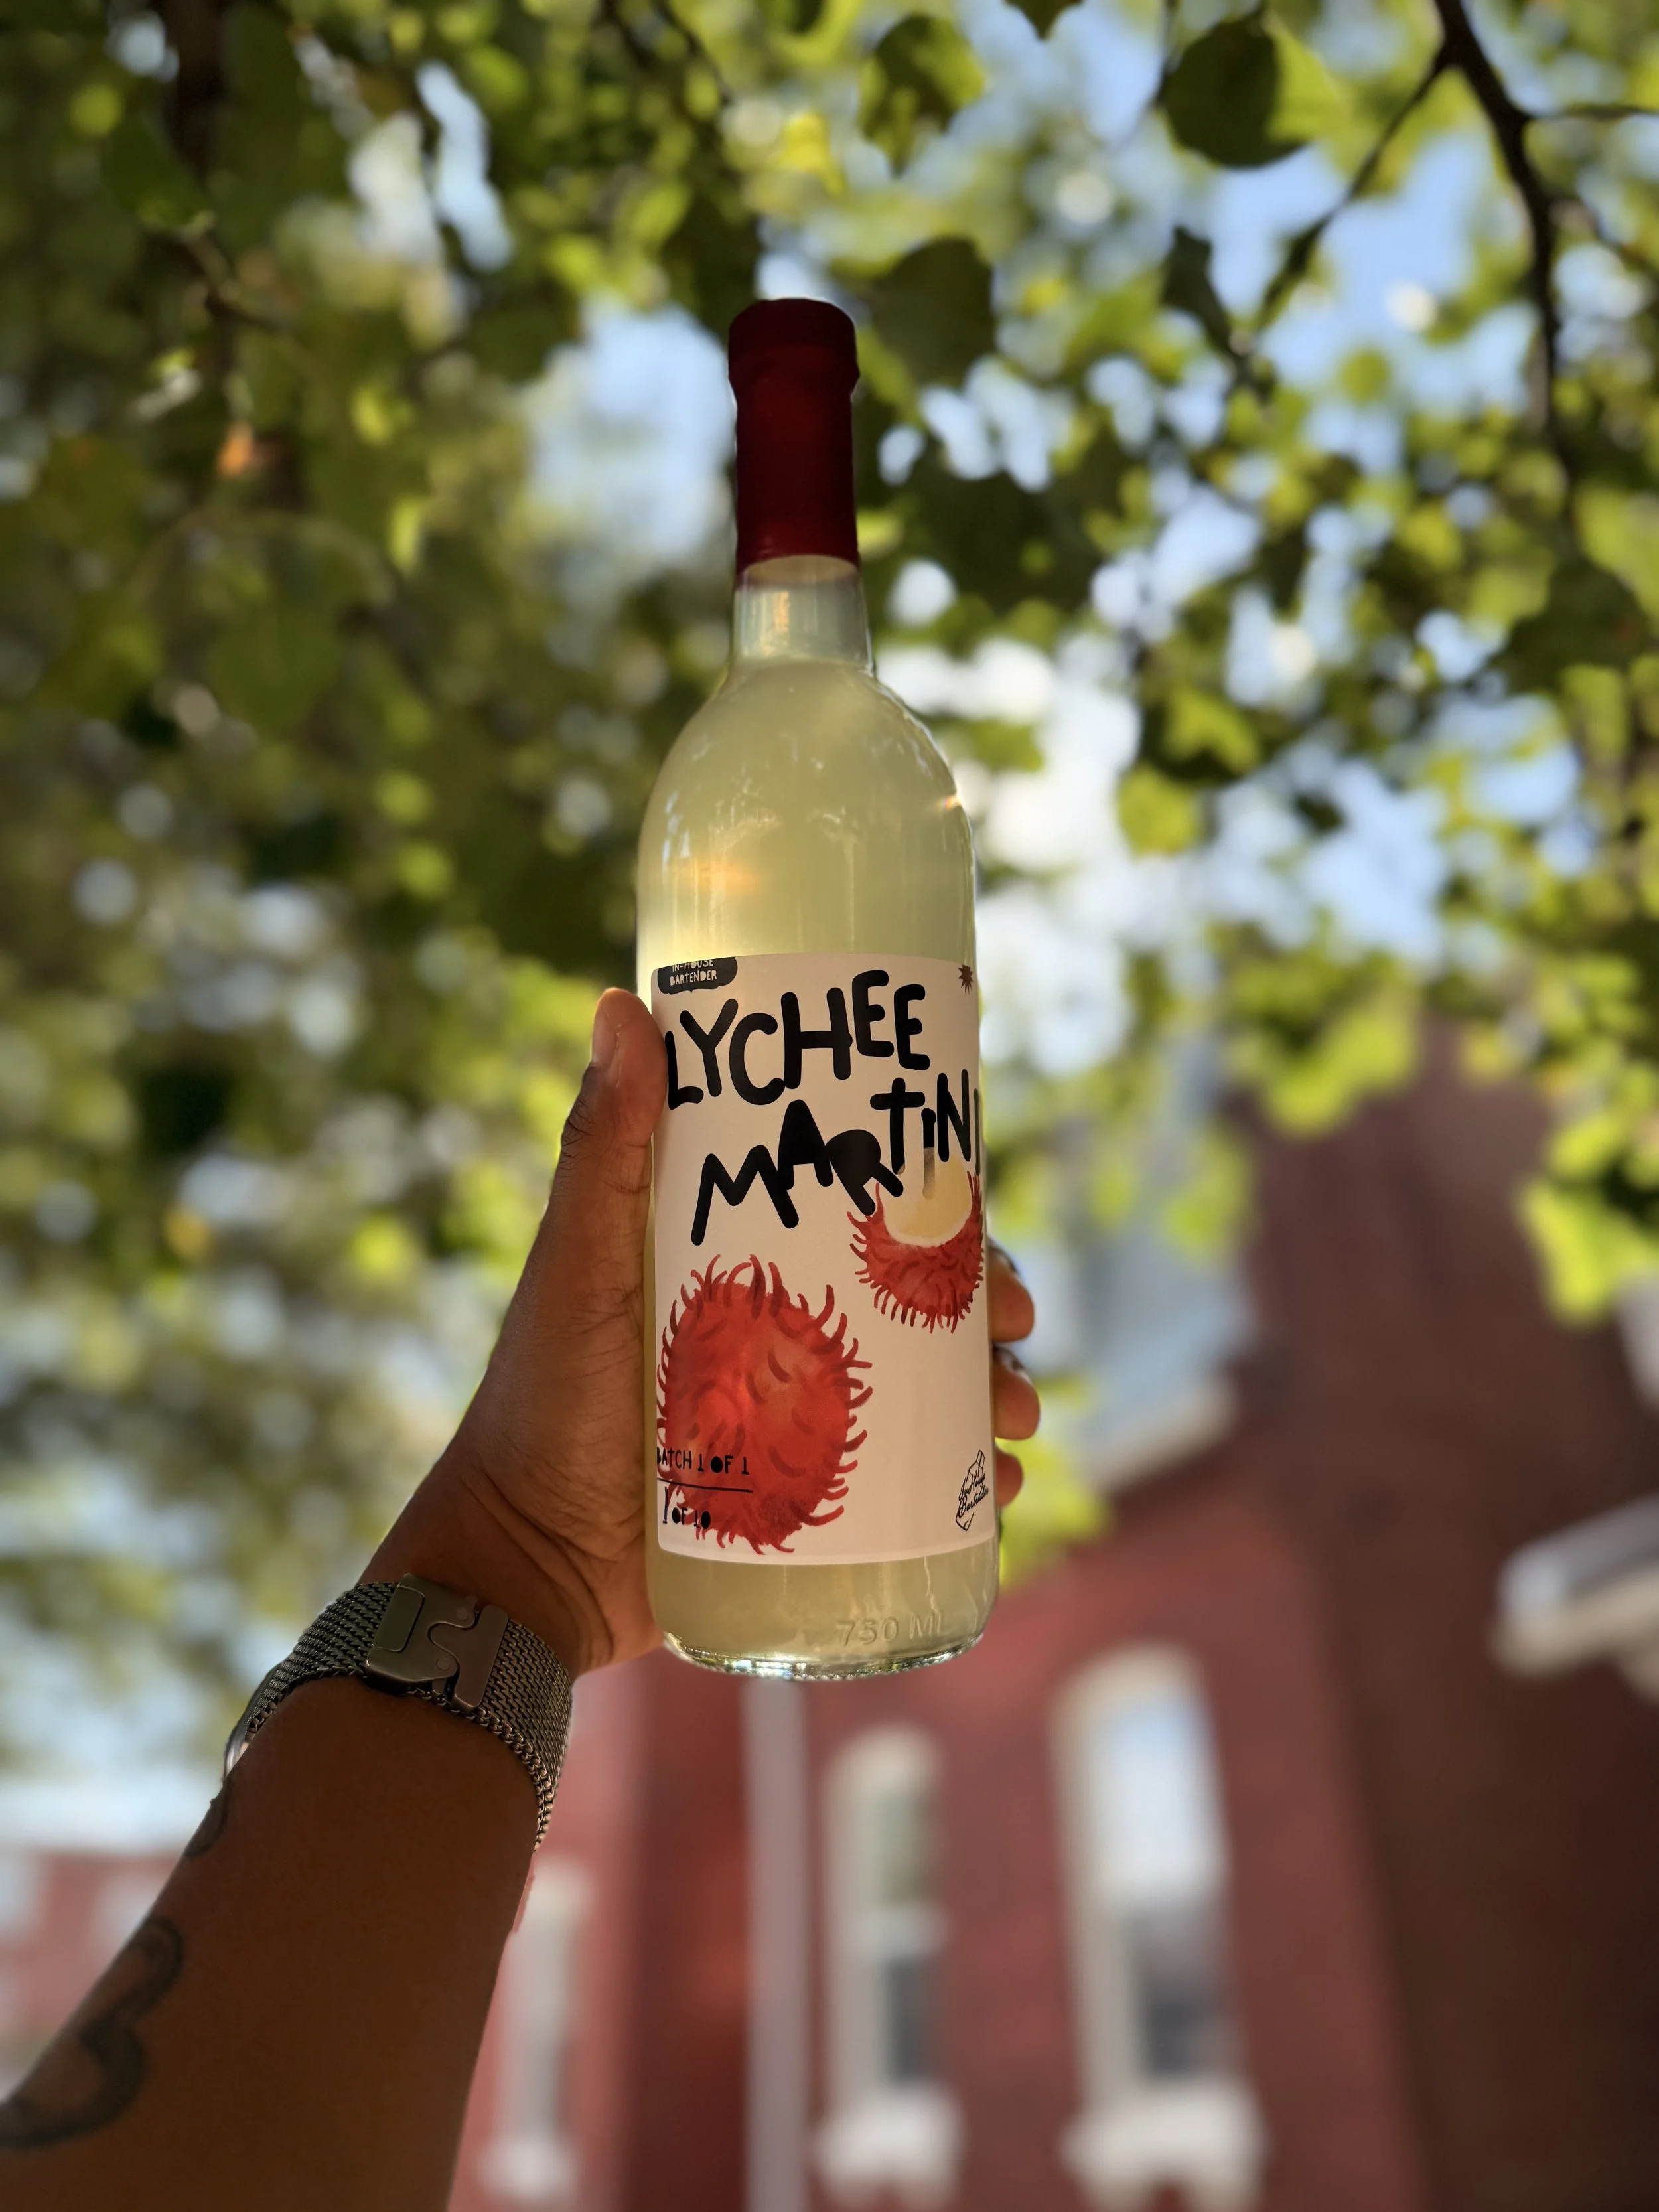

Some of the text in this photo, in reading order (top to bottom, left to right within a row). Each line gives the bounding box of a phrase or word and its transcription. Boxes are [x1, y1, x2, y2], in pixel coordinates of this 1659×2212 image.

[670, 970, 717, 986] BARTENDER
[664, 970, 930, 1110] LYCHEE
[697, 1453, 704, 1472] 1
[711, 1455, 733, 1474] OF
[741, 1456, 749, 1475] 1
[672, 1507, 688, 1525] OF
[693, 1510, 711, 1530] 10
[836, 1615, 899, 1647] 750
